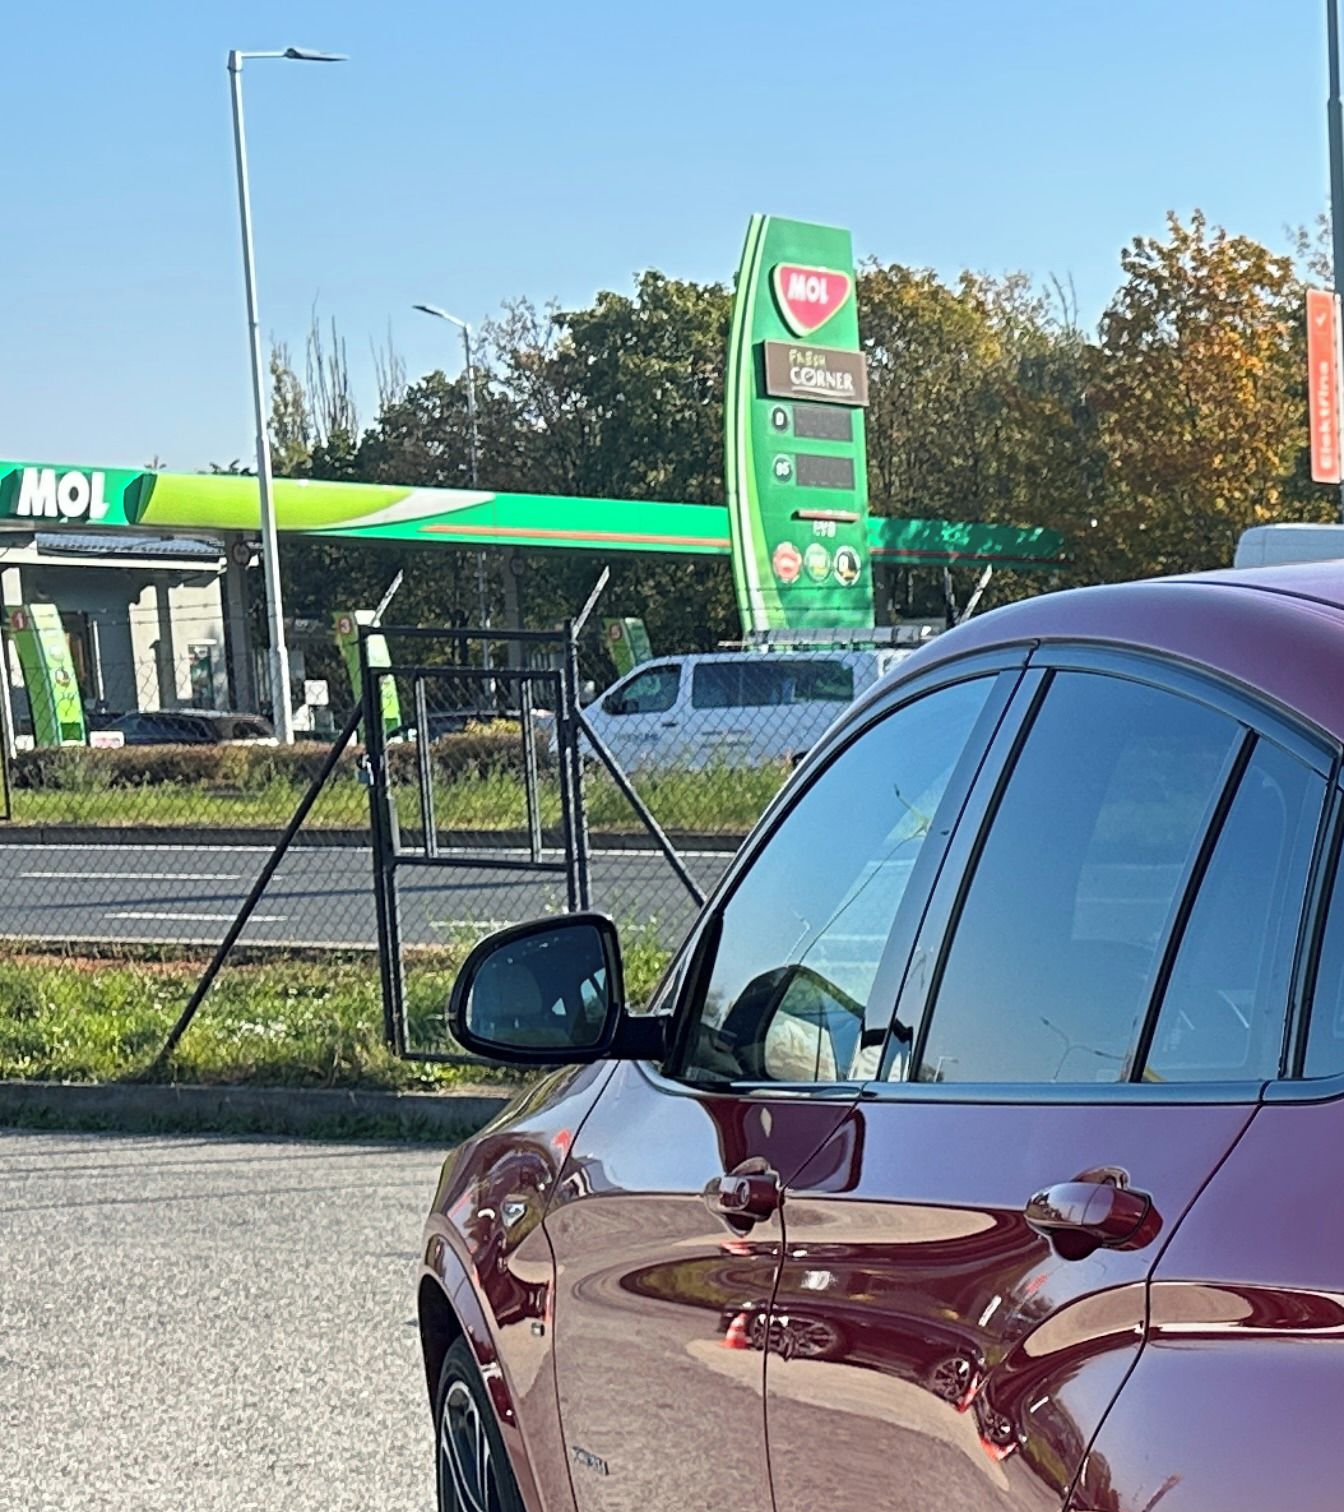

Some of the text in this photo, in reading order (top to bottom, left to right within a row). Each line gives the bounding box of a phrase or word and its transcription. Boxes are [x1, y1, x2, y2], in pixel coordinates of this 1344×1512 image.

[786, 272, 829, 304] MOL
[789, 366, 855, 392] CORNER
[16, 467, 111, 519] MOL
